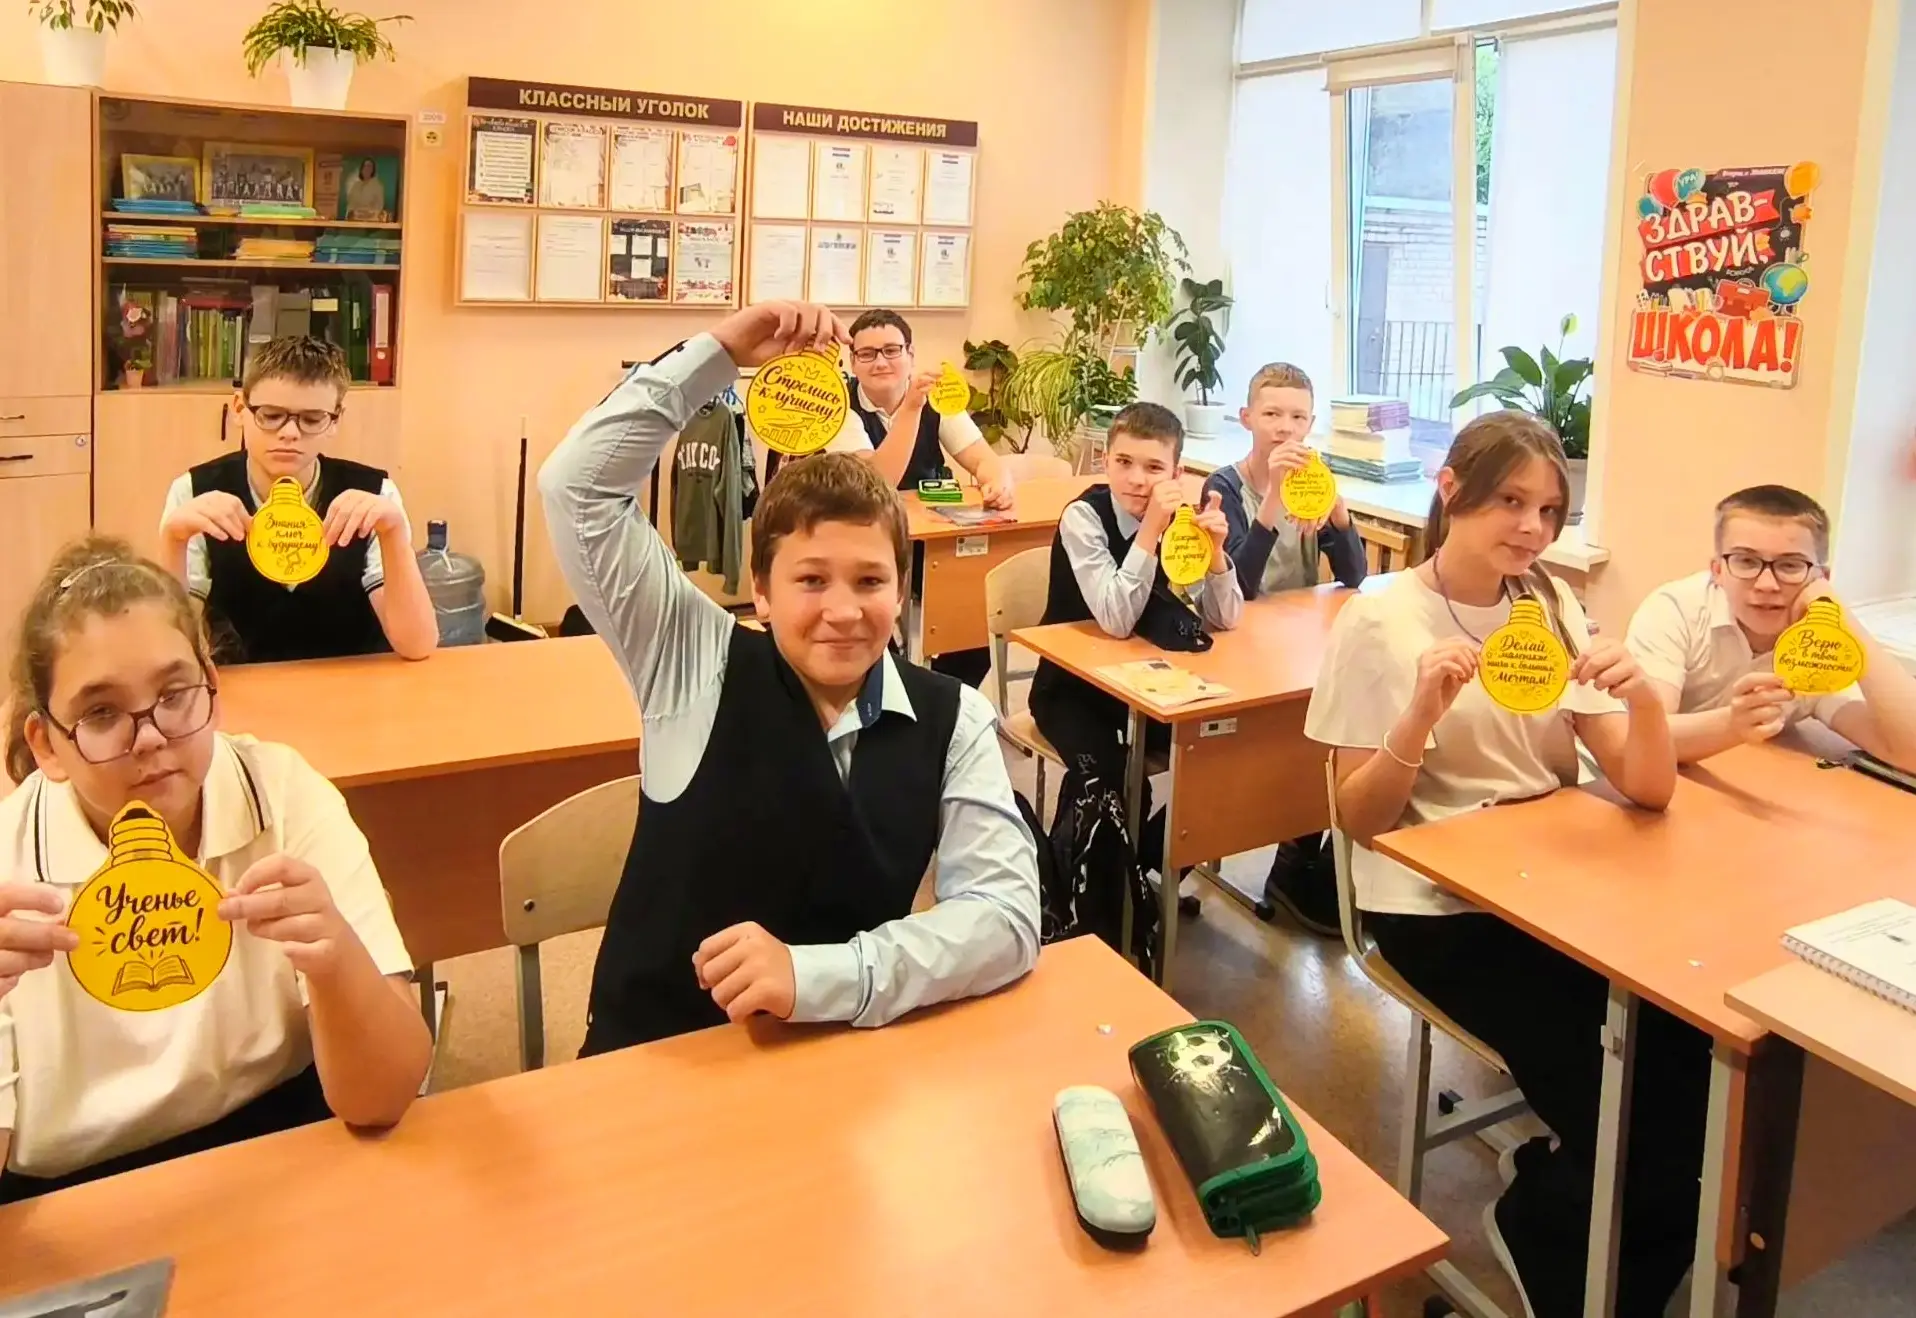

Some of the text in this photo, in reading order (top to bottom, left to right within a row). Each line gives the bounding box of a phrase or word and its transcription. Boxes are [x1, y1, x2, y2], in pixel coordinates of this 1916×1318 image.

[637, 99, 710, 119] УГОЛОК
[783, 110, 947, 138] НАШИ ДОСТИЖЕНИЯ
[1644, 190, 1768, 244] ЗДРАВ-
[1632, 311, 1800, 373] ШКОЛА!
[763, 366, 841, 405] Стремись
[771, 391, 843, 424] лучшему!
[1500, 634, 1546, 652] Делай
[1797, 629, 1842, 652] Верю
[96, 882, 201, 925] Ученье
[111, 907, 204, 954] свет!
